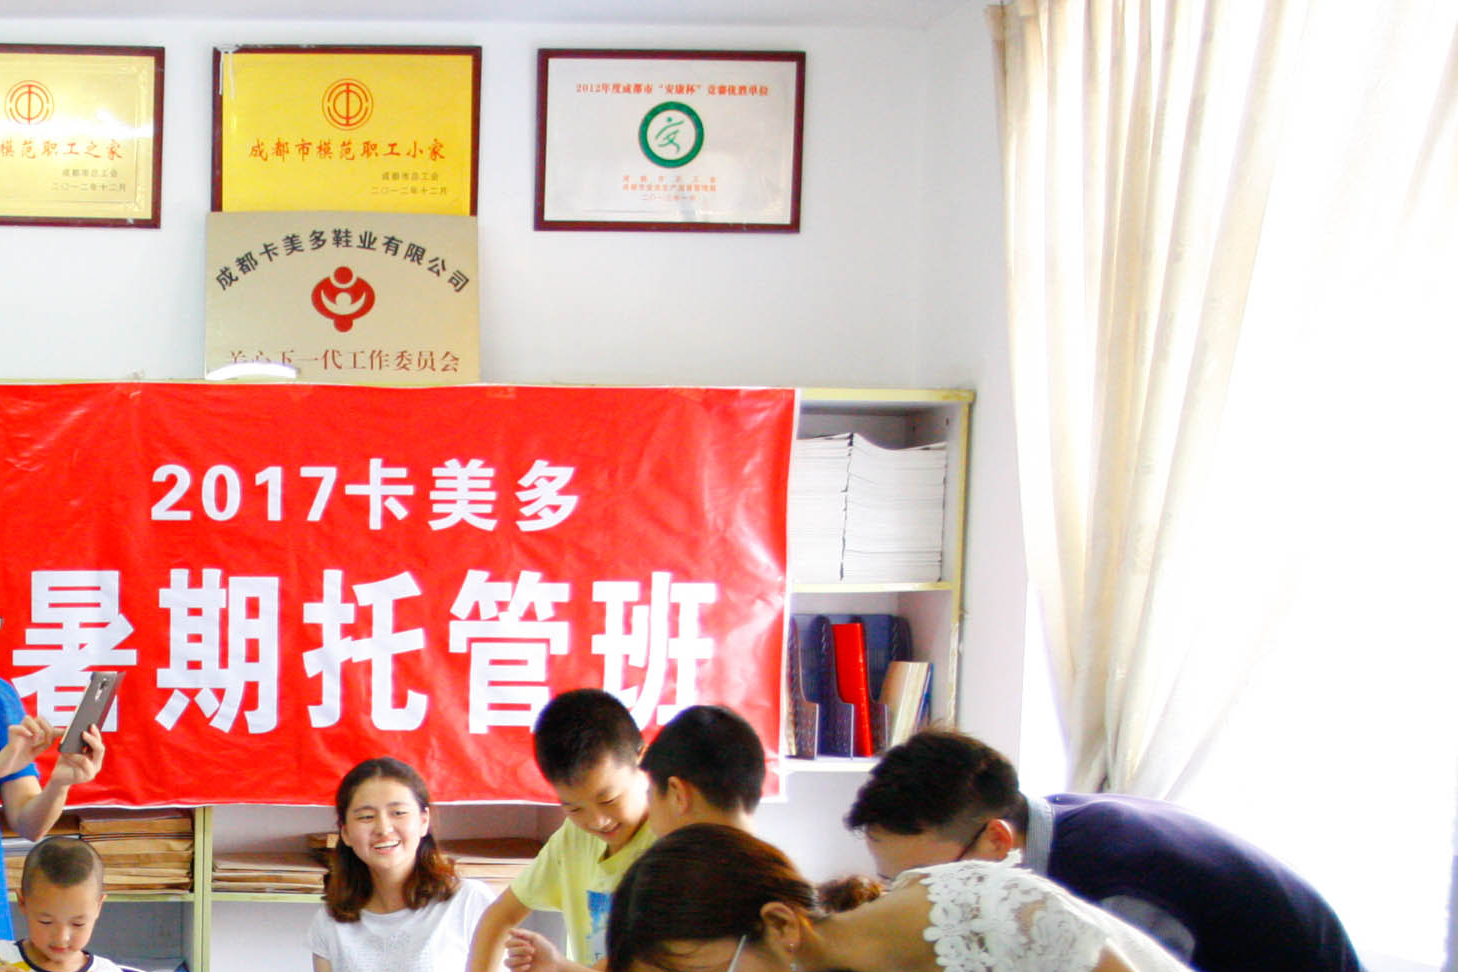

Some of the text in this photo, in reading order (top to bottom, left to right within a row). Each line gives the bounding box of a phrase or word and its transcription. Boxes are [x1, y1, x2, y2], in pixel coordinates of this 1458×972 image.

[248, 137, 447, 162] 成都市模范职工小家
[215, 228, 470, 293] 成都卡美多鞋业有限公司
[148, 457, 580, 532] 2017卡美多
[11, 567, 719, 735] 暑期托管班
